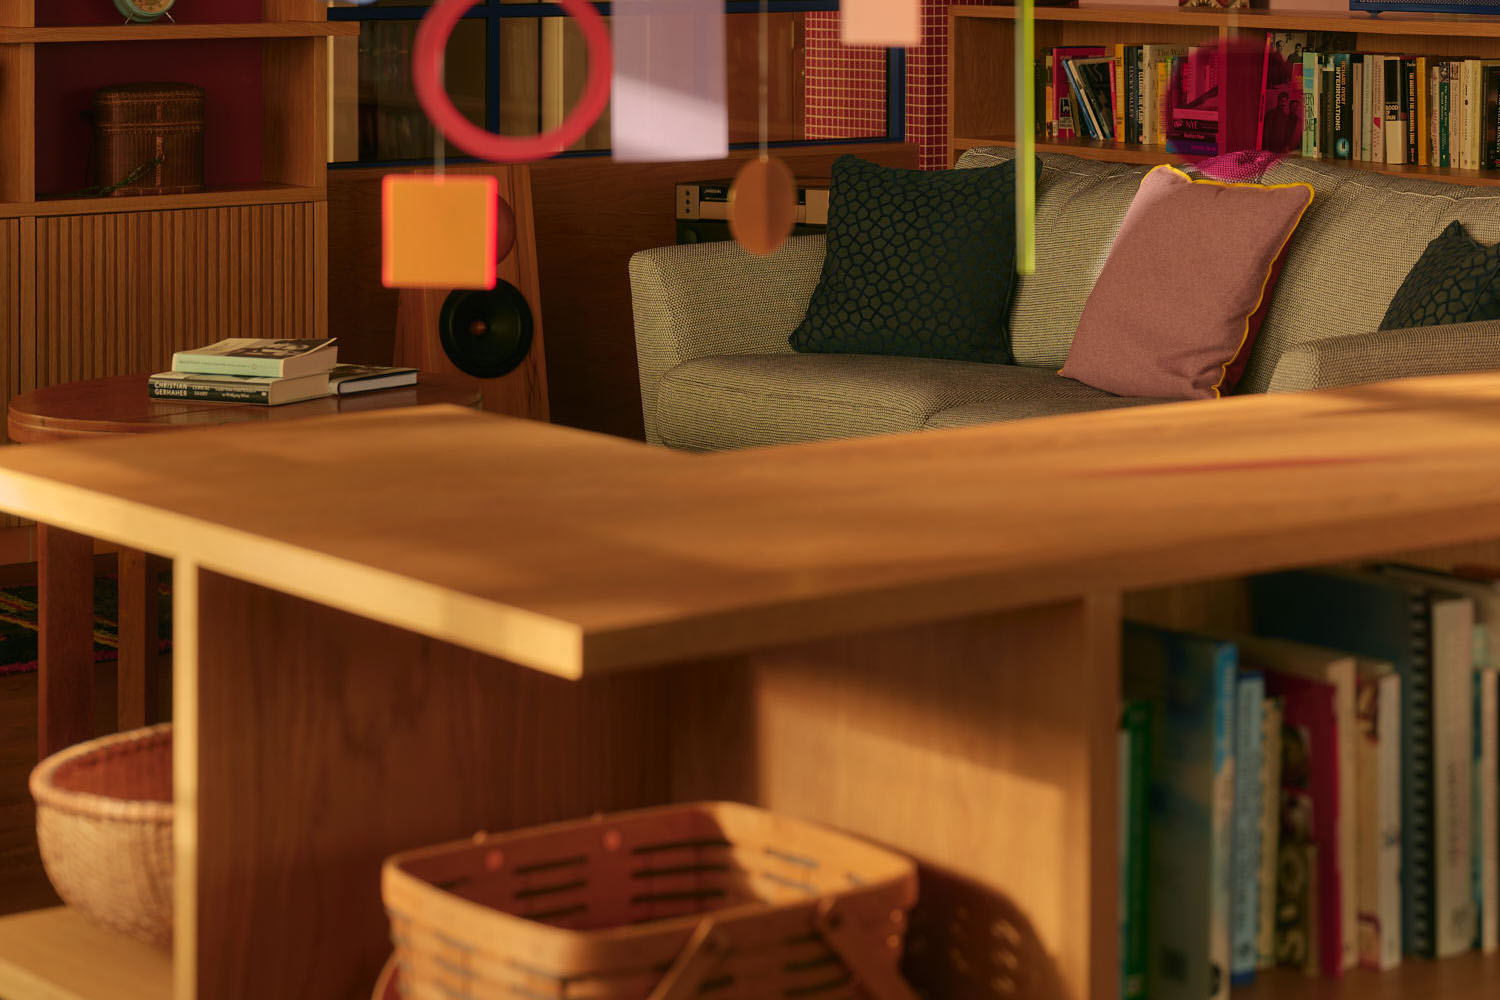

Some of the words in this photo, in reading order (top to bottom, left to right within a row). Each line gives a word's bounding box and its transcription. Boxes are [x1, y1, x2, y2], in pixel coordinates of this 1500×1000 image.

[1127, 65, 1135, 90] LUCKY
[1127, 91, 1135, 119] VALLEY
[154, 389, 187, 397] GERHAHER
